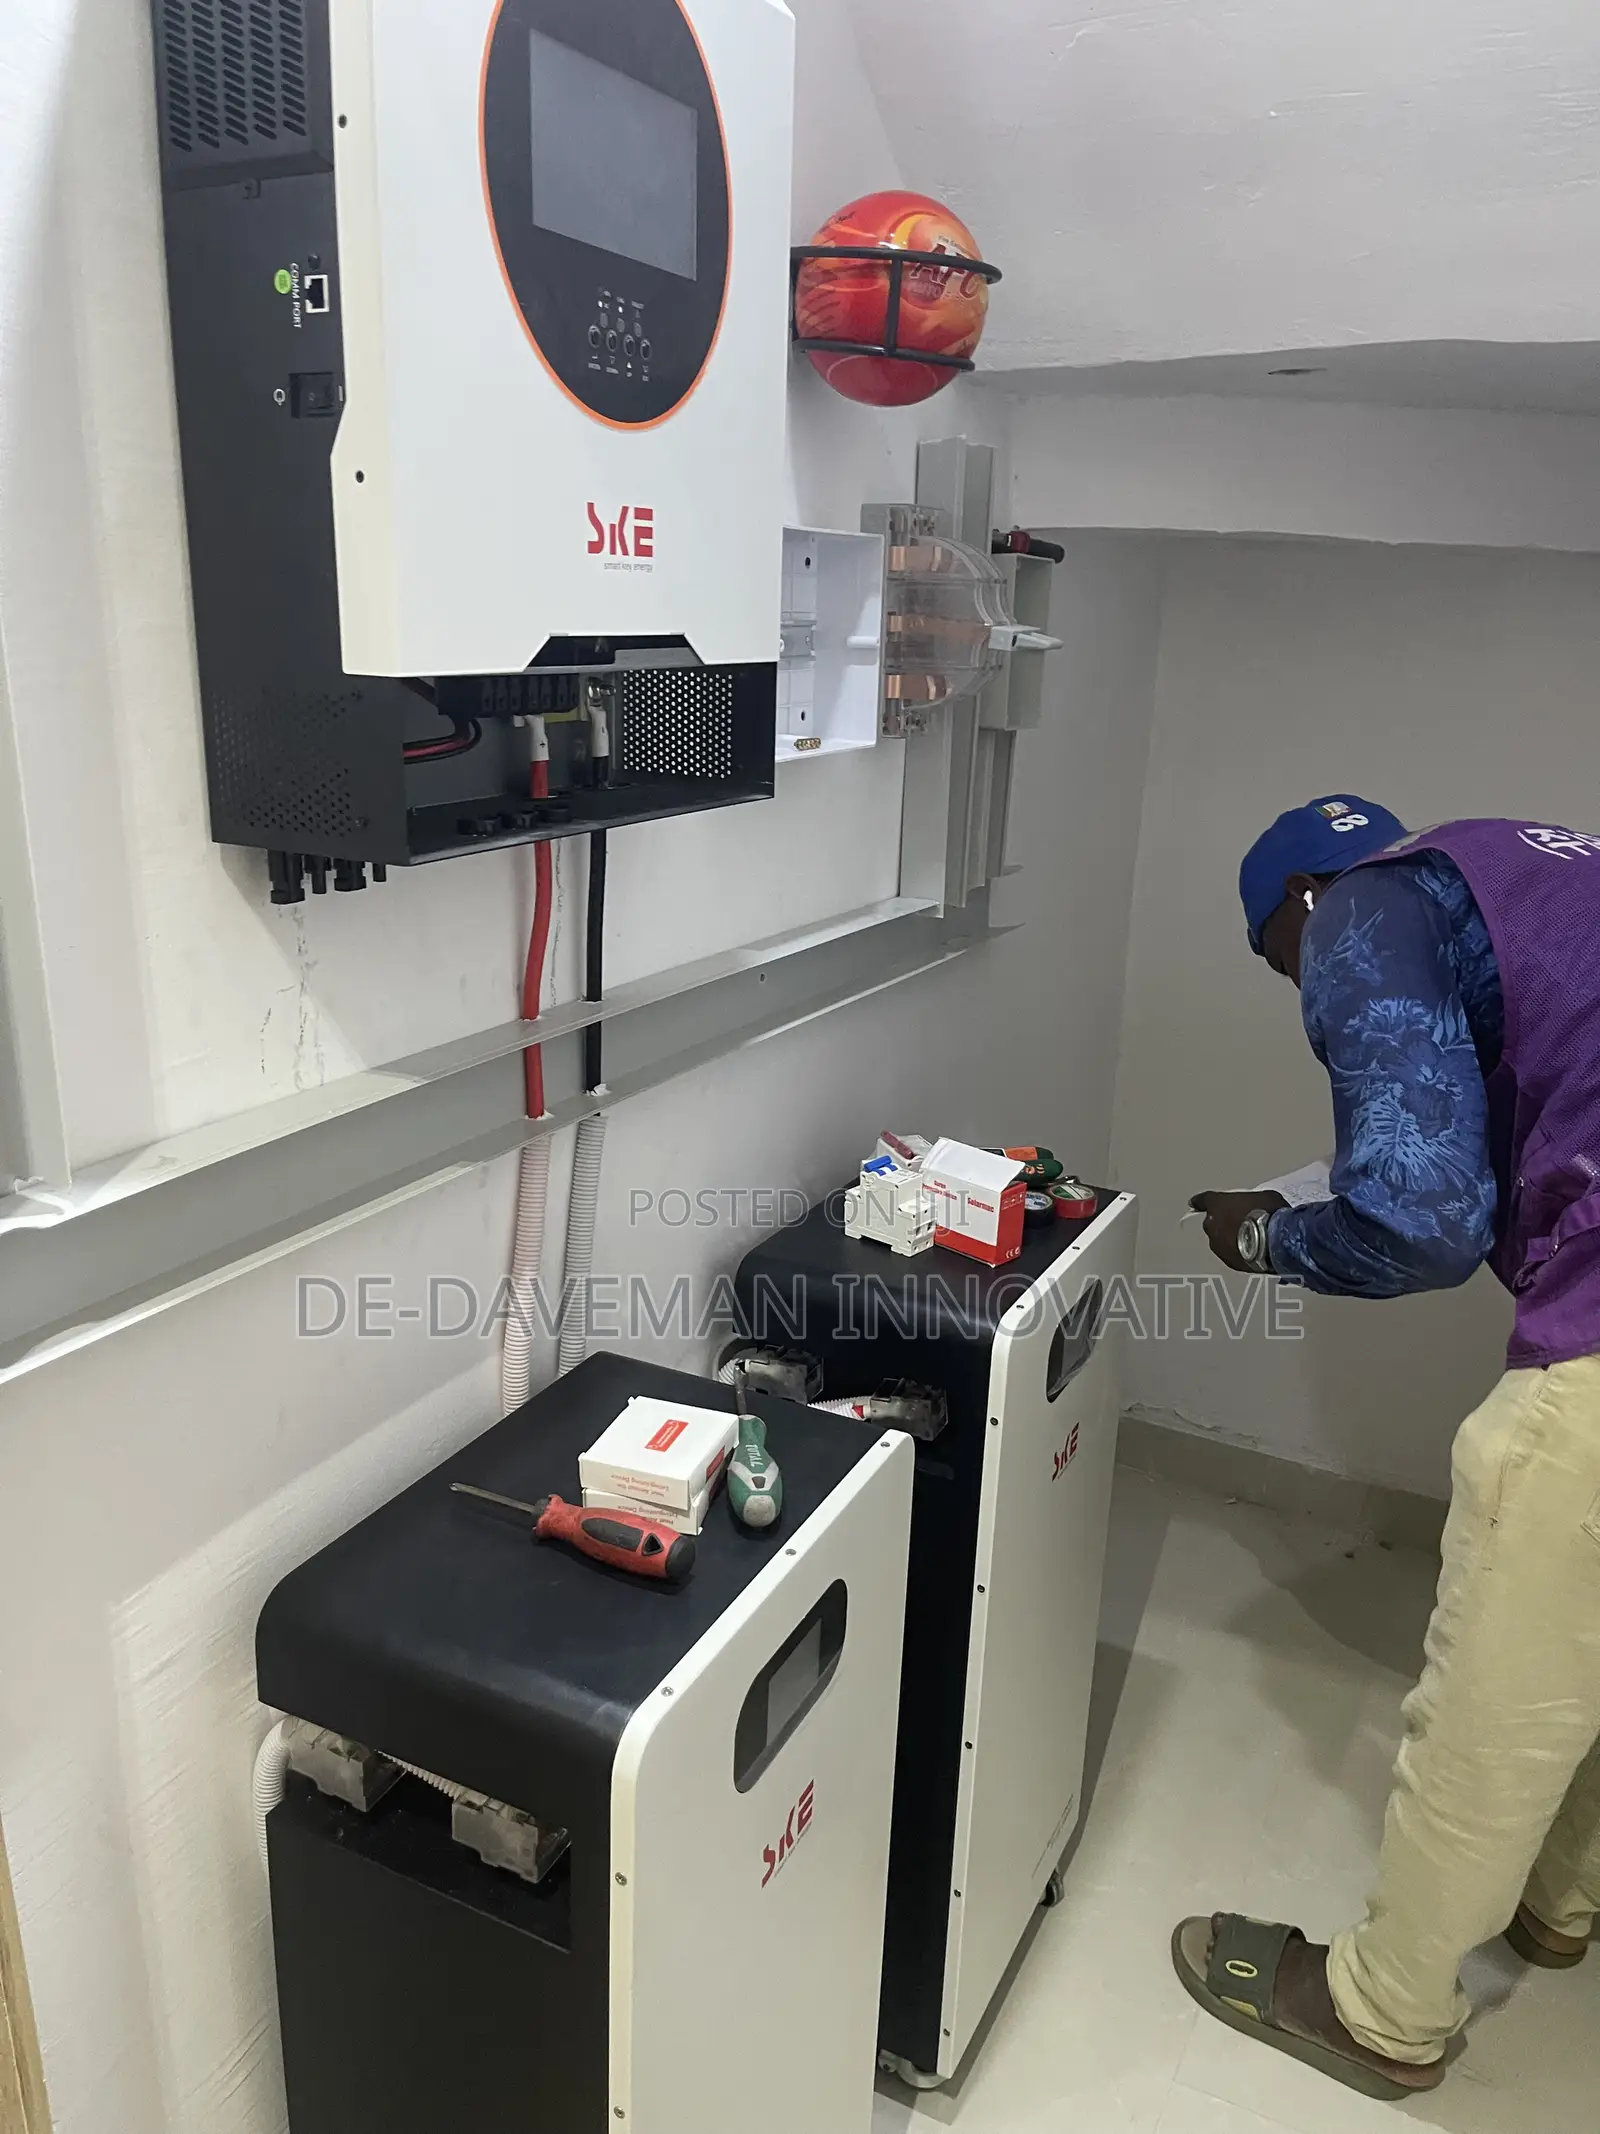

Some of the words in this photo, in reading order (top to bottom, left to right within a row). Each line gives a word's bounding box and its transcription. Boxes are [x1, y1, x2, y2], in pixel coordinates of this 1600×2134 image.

[290, 262, 301, 299] COMM
[292, 301, 302, 328] PORT
[587, 501, 653, 557] SKE
[745, 1444, 764, 1467] TOTAL
[1051, 1421, 1080, 1482] SKE
[761, 1778, 814, 1889] SKE
